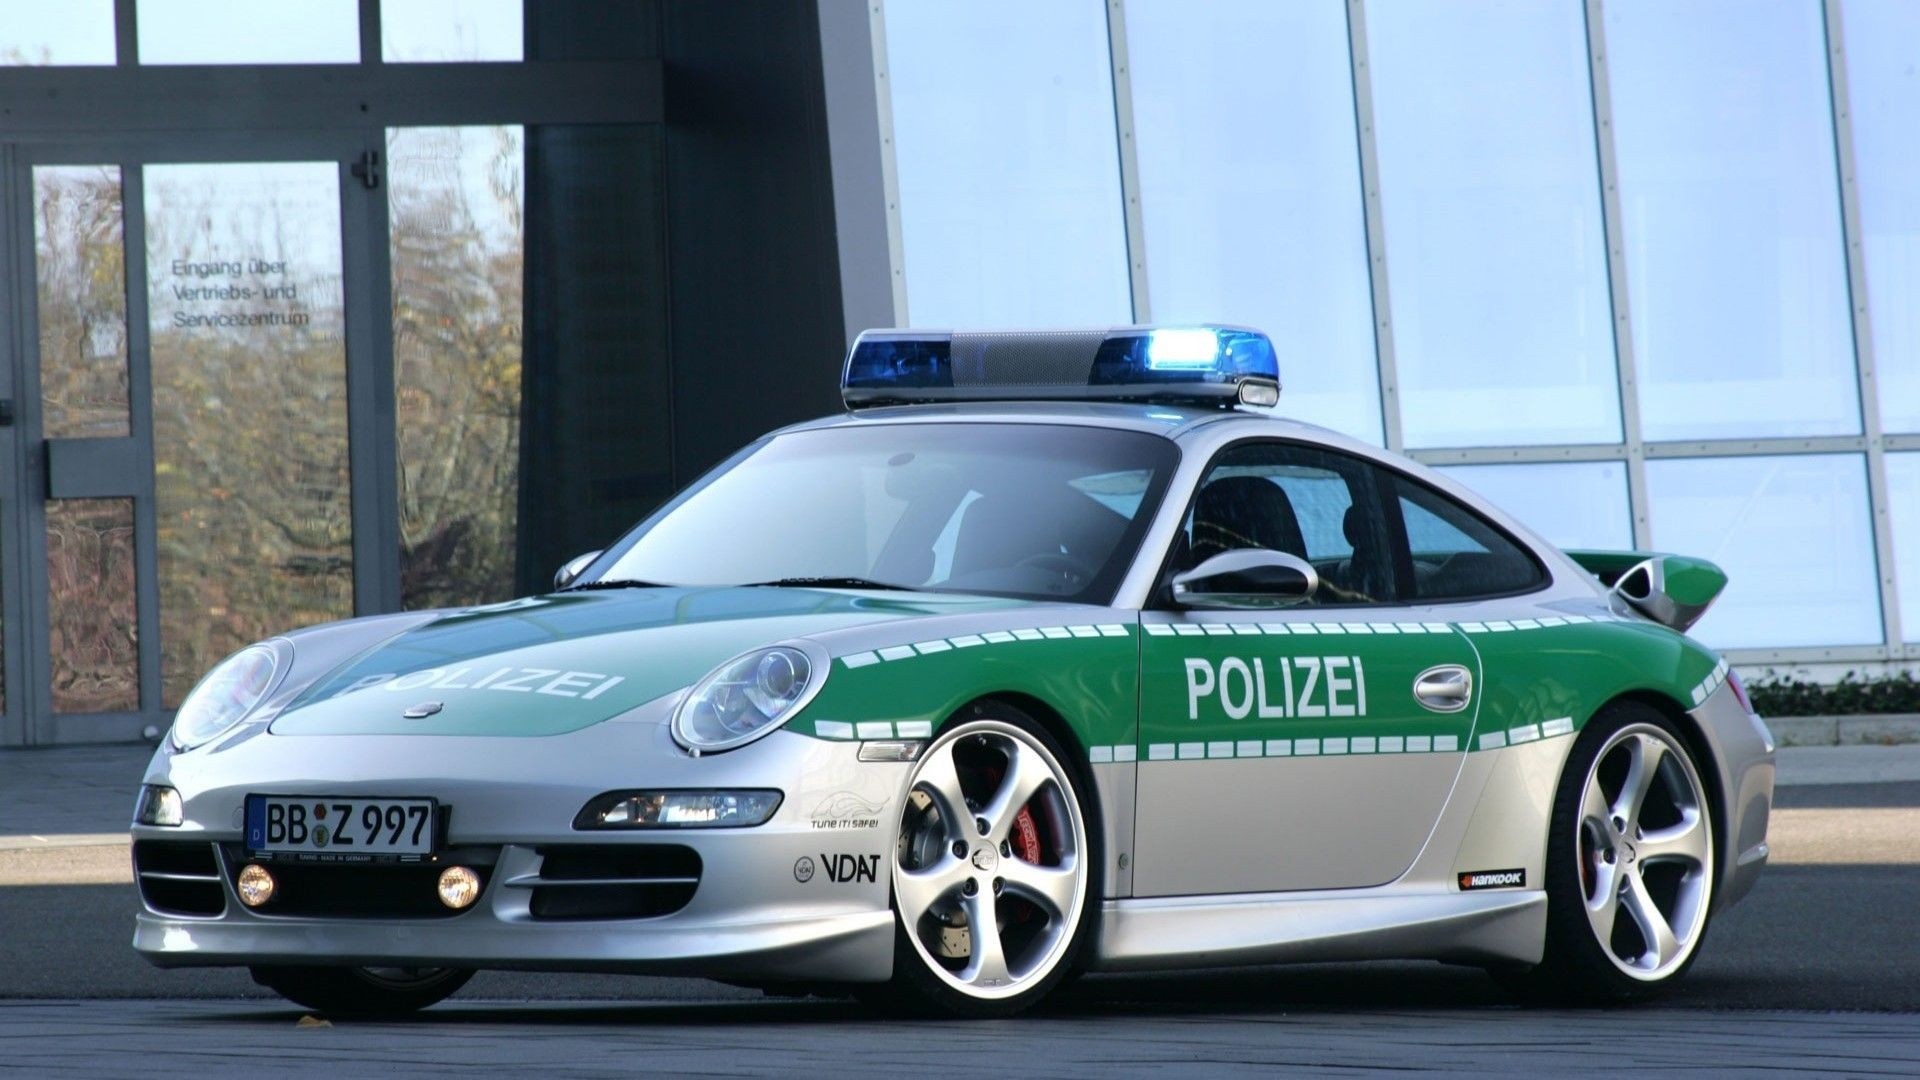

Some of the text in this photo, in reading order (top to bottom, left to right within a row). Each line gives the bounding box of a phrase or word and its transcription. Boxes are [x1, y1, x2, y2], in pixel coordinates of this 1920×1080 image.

[172, 258, 286, 278] Eingang über
[173, 284, 296, 300] Vertriebs- und
[174, 311, 309, 328] Servicezentrum
[330, 667, 625, 699] POLIZEI
[1184, 656, 1367, 720] POLIZEI
[253, 831, 259, 841] D
[267, 803, 429, 846] BB Z 997
[820, 853, 881, 883] VDAT
